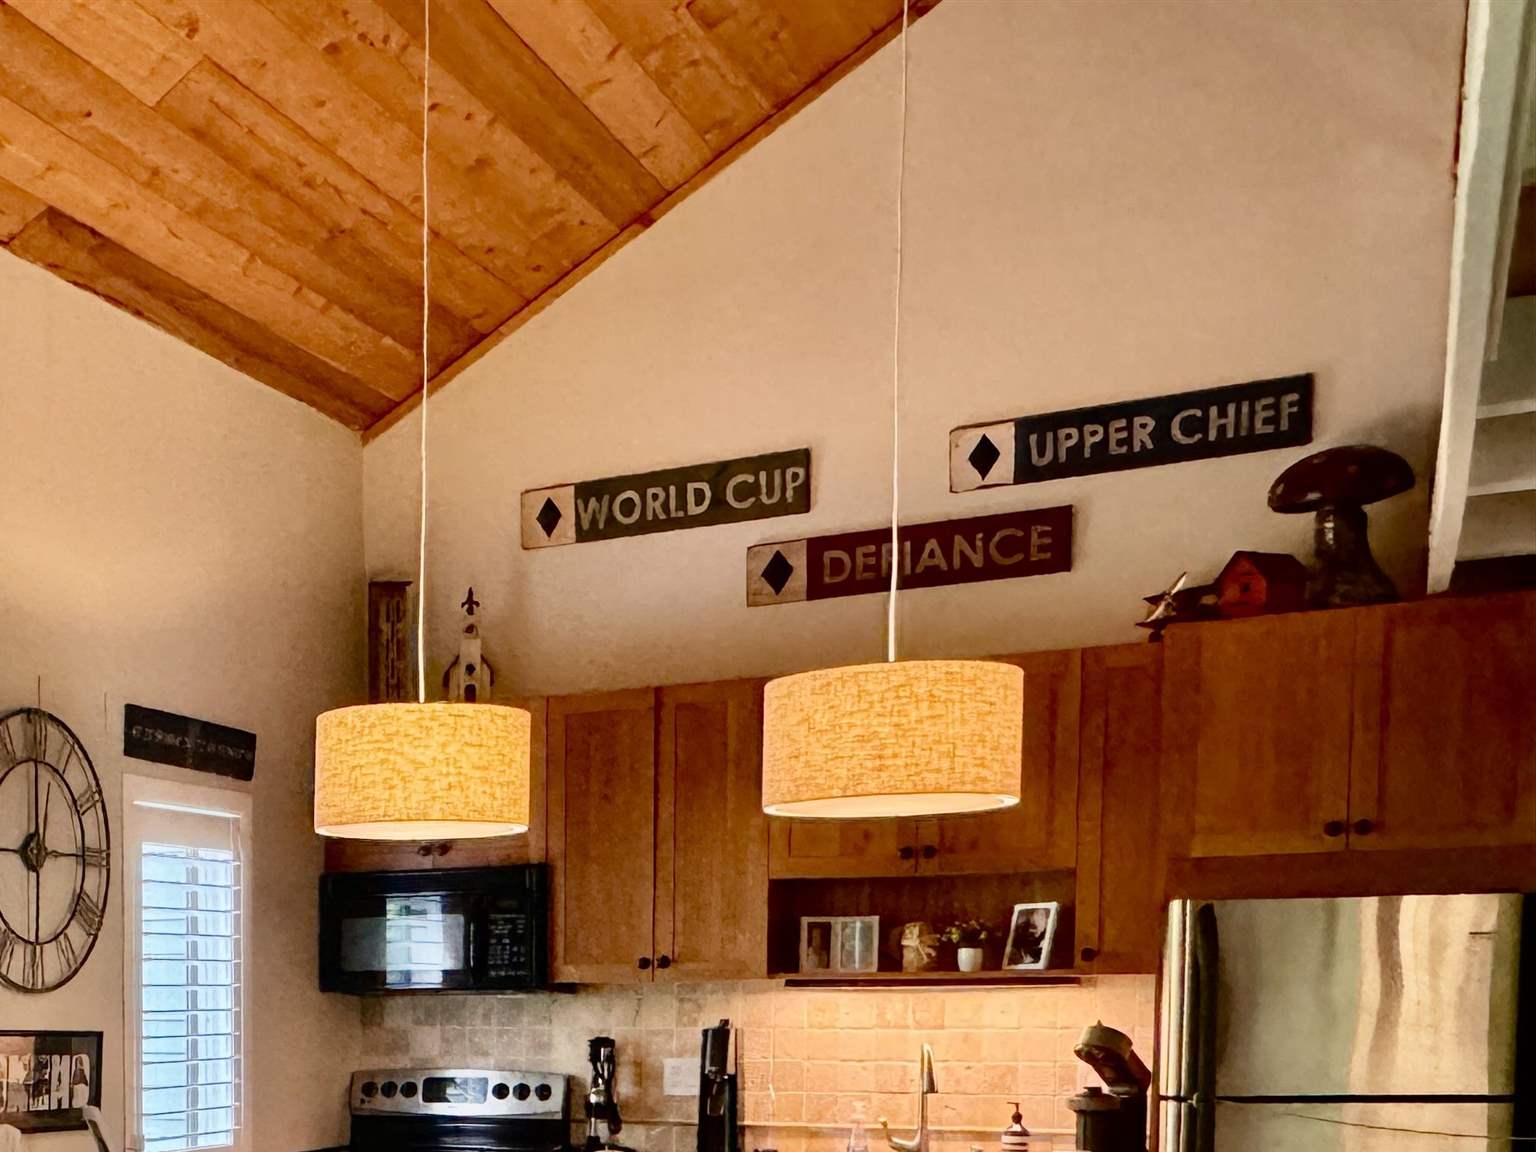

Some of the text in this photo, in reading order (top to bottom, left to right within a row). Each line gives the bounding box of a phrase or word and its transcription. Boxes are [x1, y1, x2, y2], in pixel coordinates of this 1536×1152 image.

[1028, 393, 1301, 467] UPPER CHIEF
[577, 466, 805, 531] WORLD CUP
[822, 525, 1053, 584] DEFIANCE
